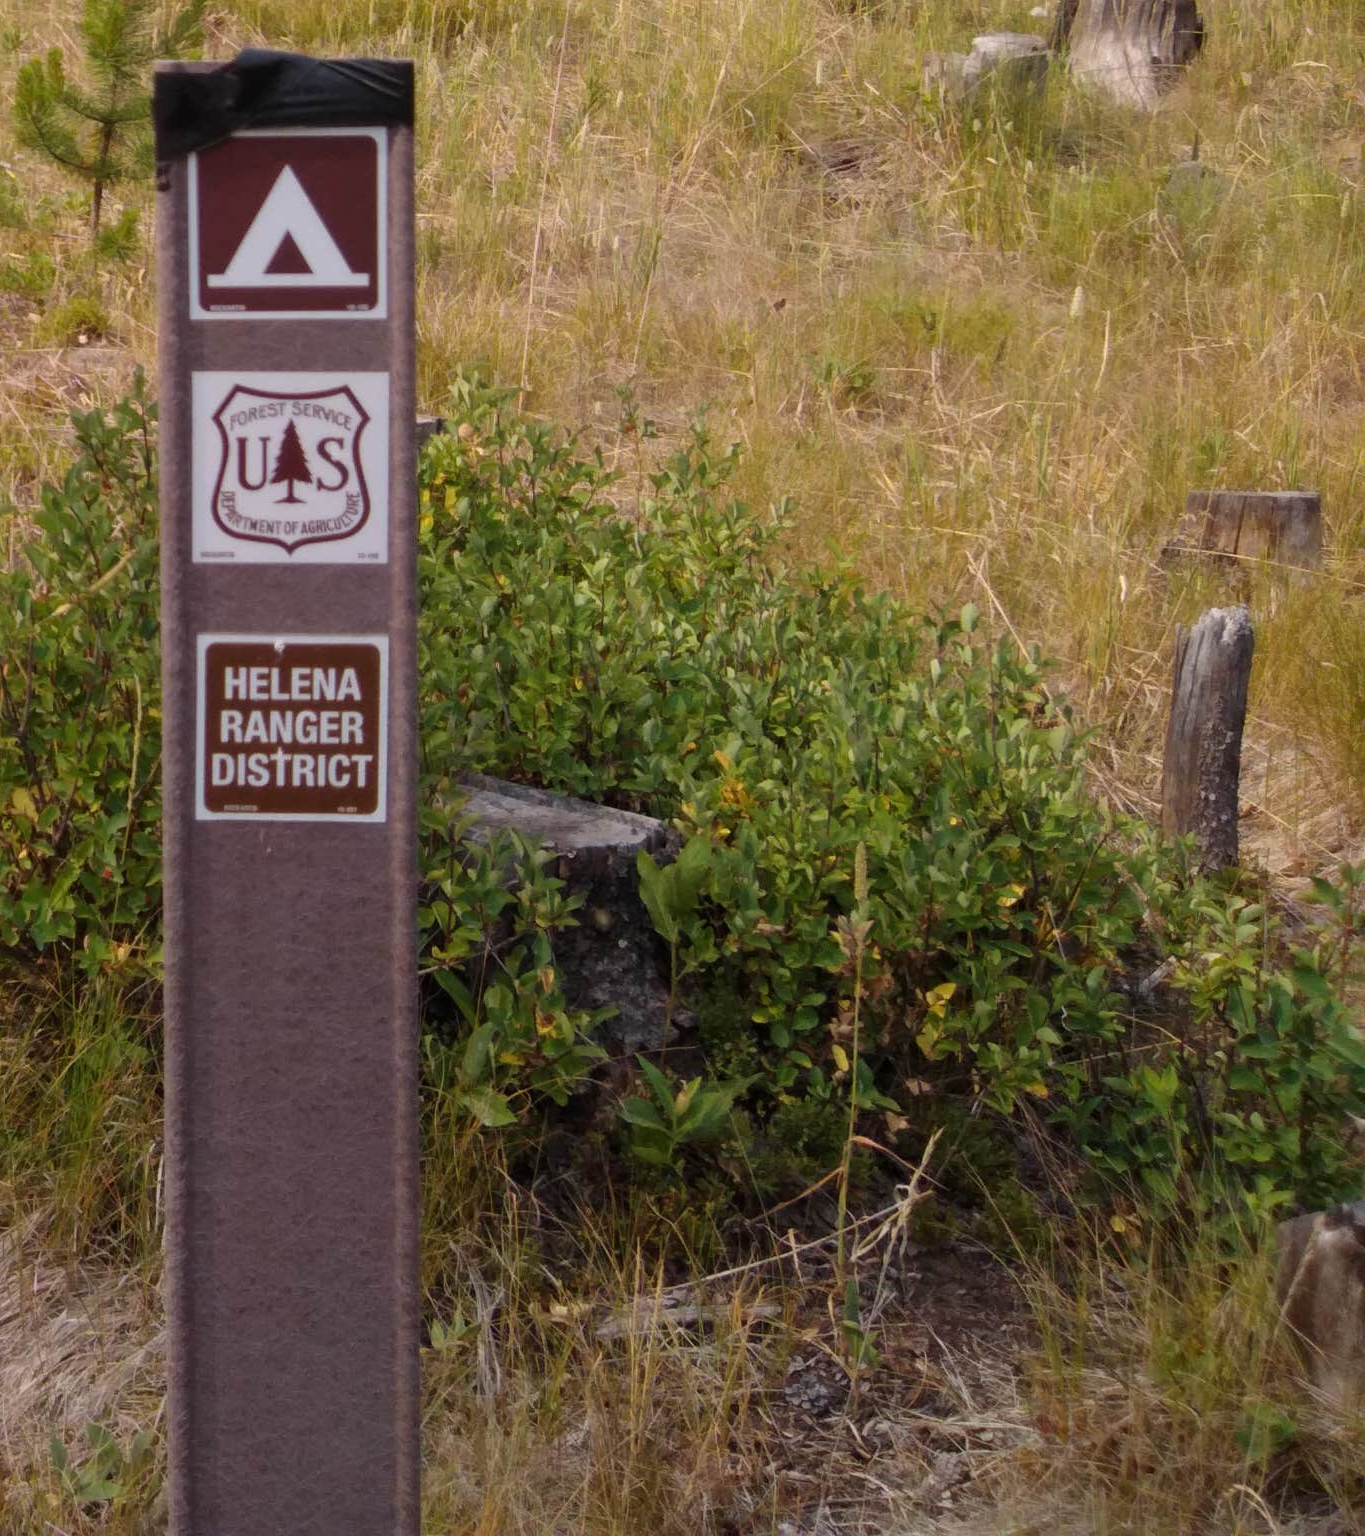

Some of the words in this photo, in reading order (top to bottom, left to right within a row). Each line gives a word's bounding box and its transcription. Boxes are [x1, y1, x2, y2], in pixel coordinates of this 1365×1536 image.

[230, 402, 286, 431] FOREST
[291, 401, 352, 431] SERVICE
[236, 437, 271, 491] U
[316, 437, 349, 491] S
[221, 491, 279, 534] DEPARTMENT
[284, 521, 298, 535] OF
[301, 491, 360, 534] AGRICULTURE
[224, 667, 362, 701] HELENA
[221, 710, 364, 744] RANGER
[212, 753, 373, 788] DISTRICT
